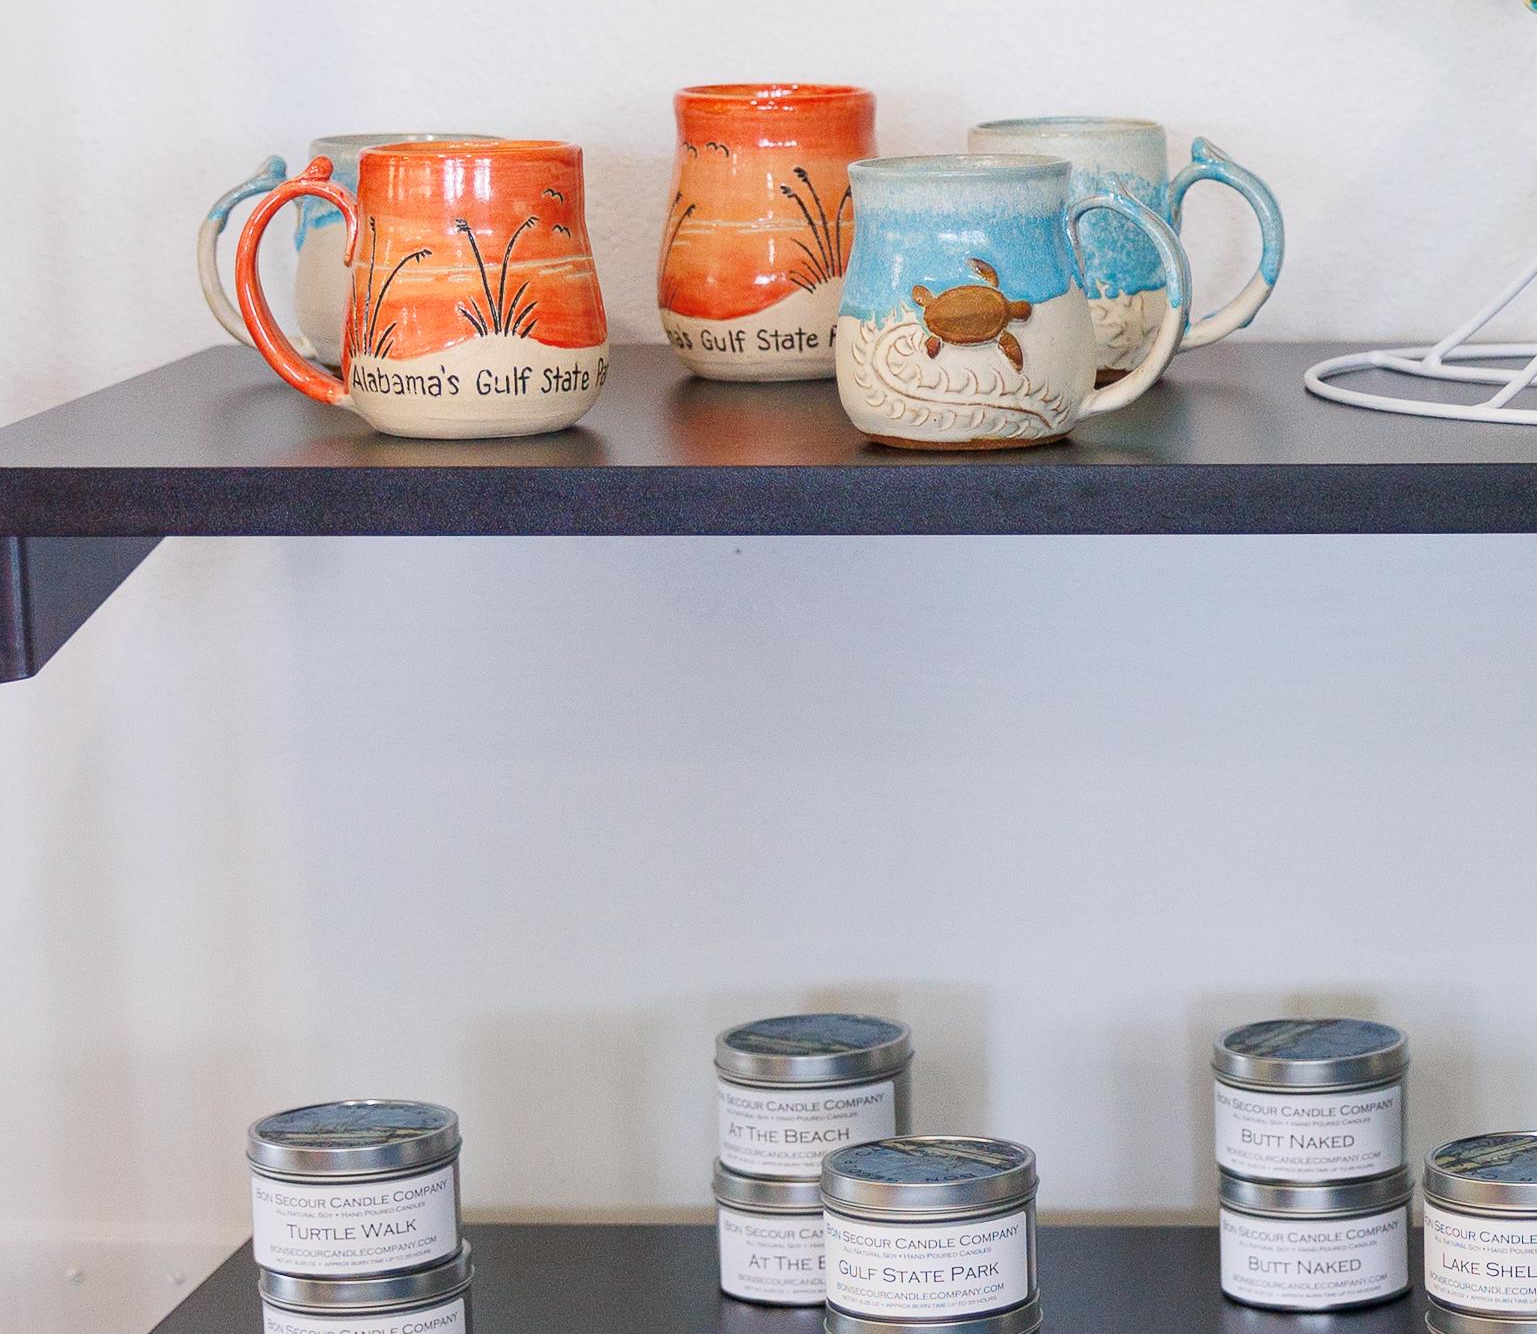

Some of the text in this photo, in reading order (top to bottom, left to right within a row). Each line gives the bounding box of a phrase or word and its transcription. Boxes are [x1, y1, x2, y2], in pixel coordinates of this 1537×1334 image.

[701, 329, 746, 353] Gulf
[757, 327, 819, 353] State
[352, 365, 460, 397] Alabama's
[476, 366, 533, 396] Gulf
[540, 363, 590, 394] State
[784, 1128, 850, 1143] BEACH
[287, 1219, 417, 1241] TURTLE WALK
[838, 1259, 1000, 1283] GULF STATE PARK
[1442, 1253, 1481, 1276] LAKE
